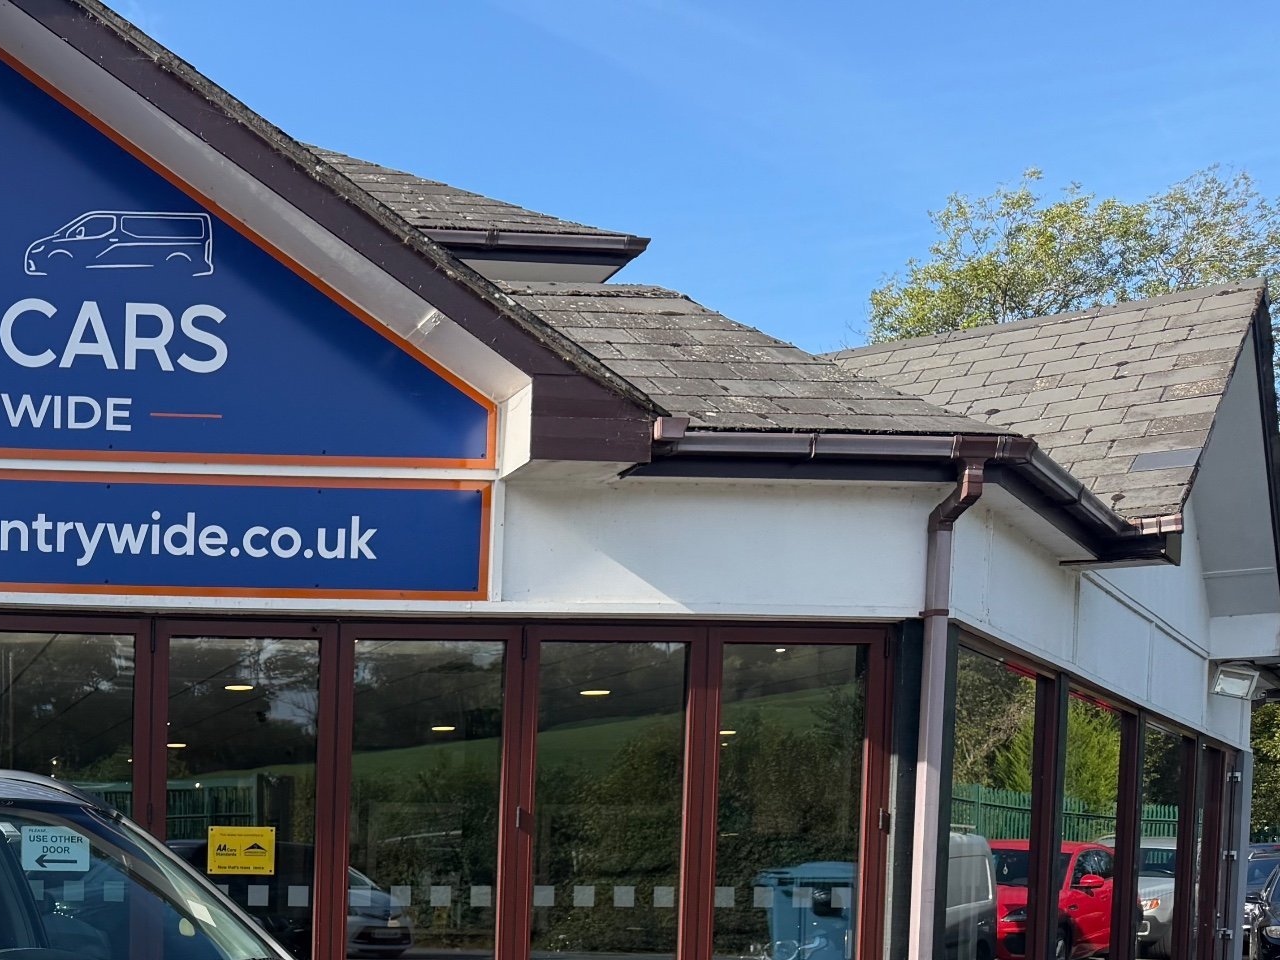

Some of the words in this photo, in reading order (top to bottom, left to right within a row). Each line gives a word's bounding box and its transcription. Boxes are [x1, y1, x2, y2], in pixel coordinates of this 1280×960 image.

[0, 298, 228, 374] CARS
[28, 835, 48, 843] USE
[50, 835, 83, 844] OTHER
[42, 845, 70, 854] DOOR
[216, 843, 227, 852] AA
